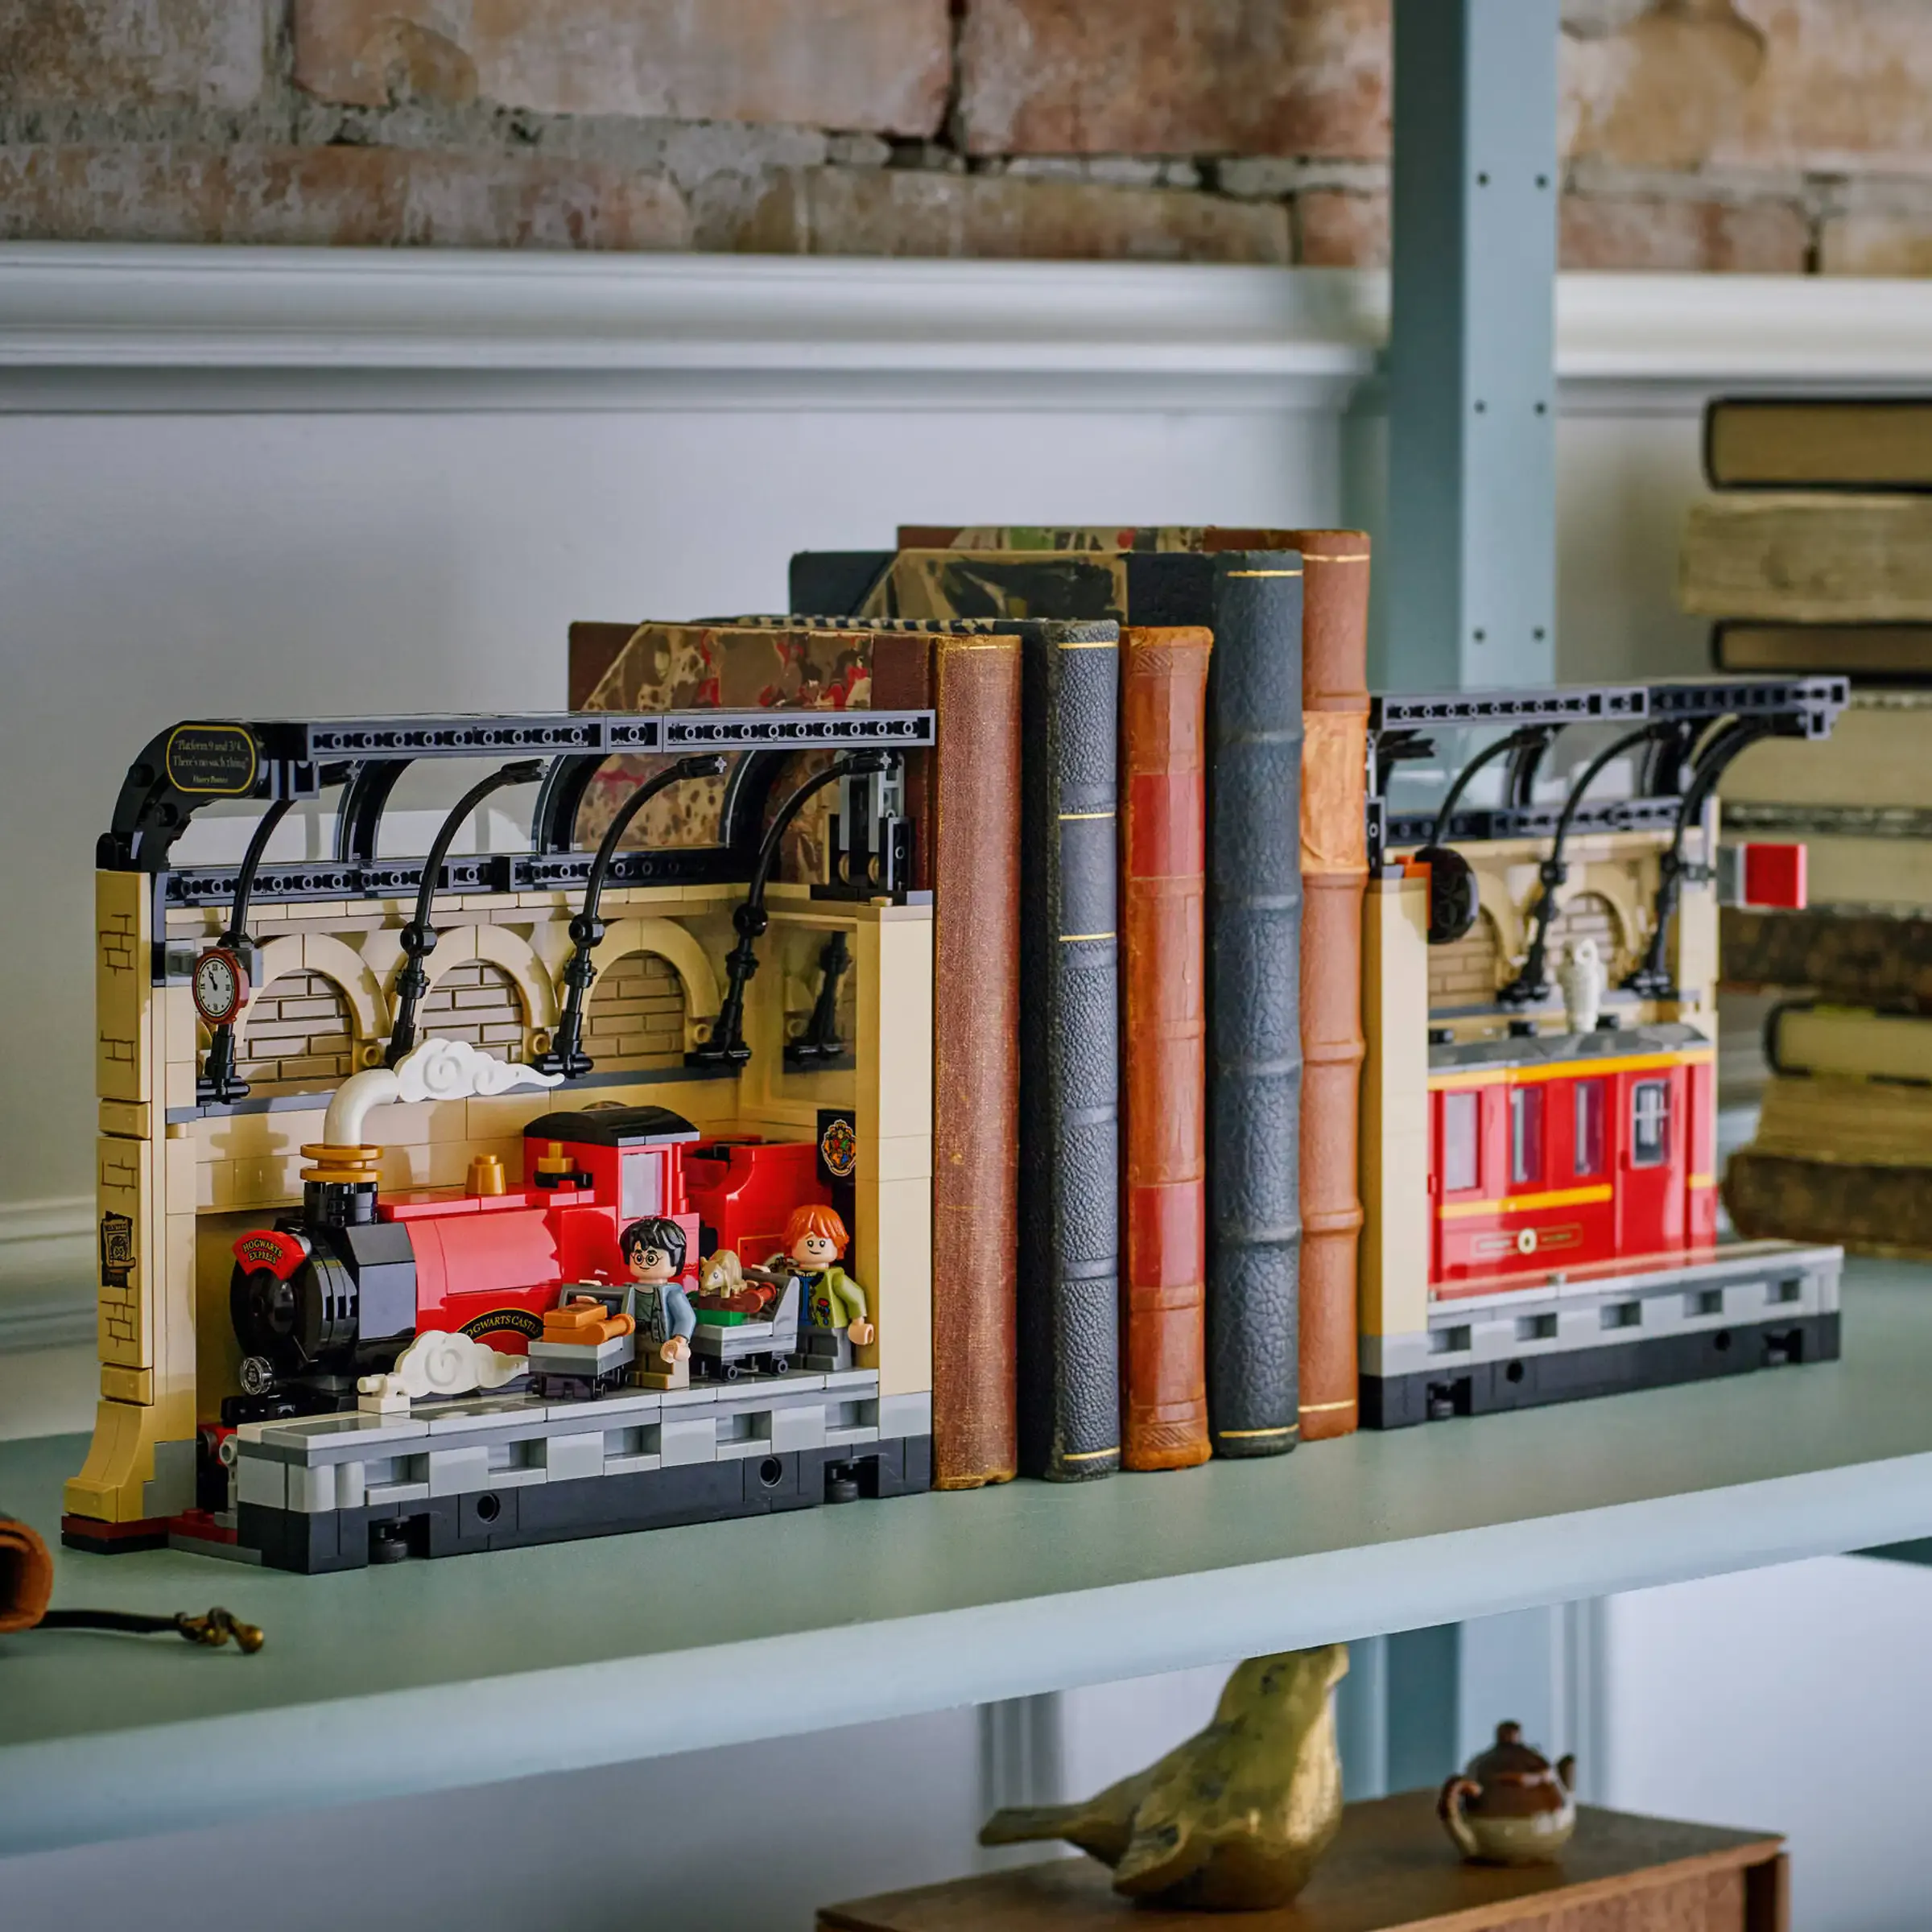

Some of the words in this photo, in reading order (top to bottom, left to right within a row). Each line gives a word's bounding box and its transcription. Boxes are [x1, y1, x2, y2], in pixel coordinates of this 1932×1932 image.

[214, 741, 227, 751] and
[242, 1239, 283, 1257] HOGWARTS
[466, 1315, 511, 1336] OGWARTS
